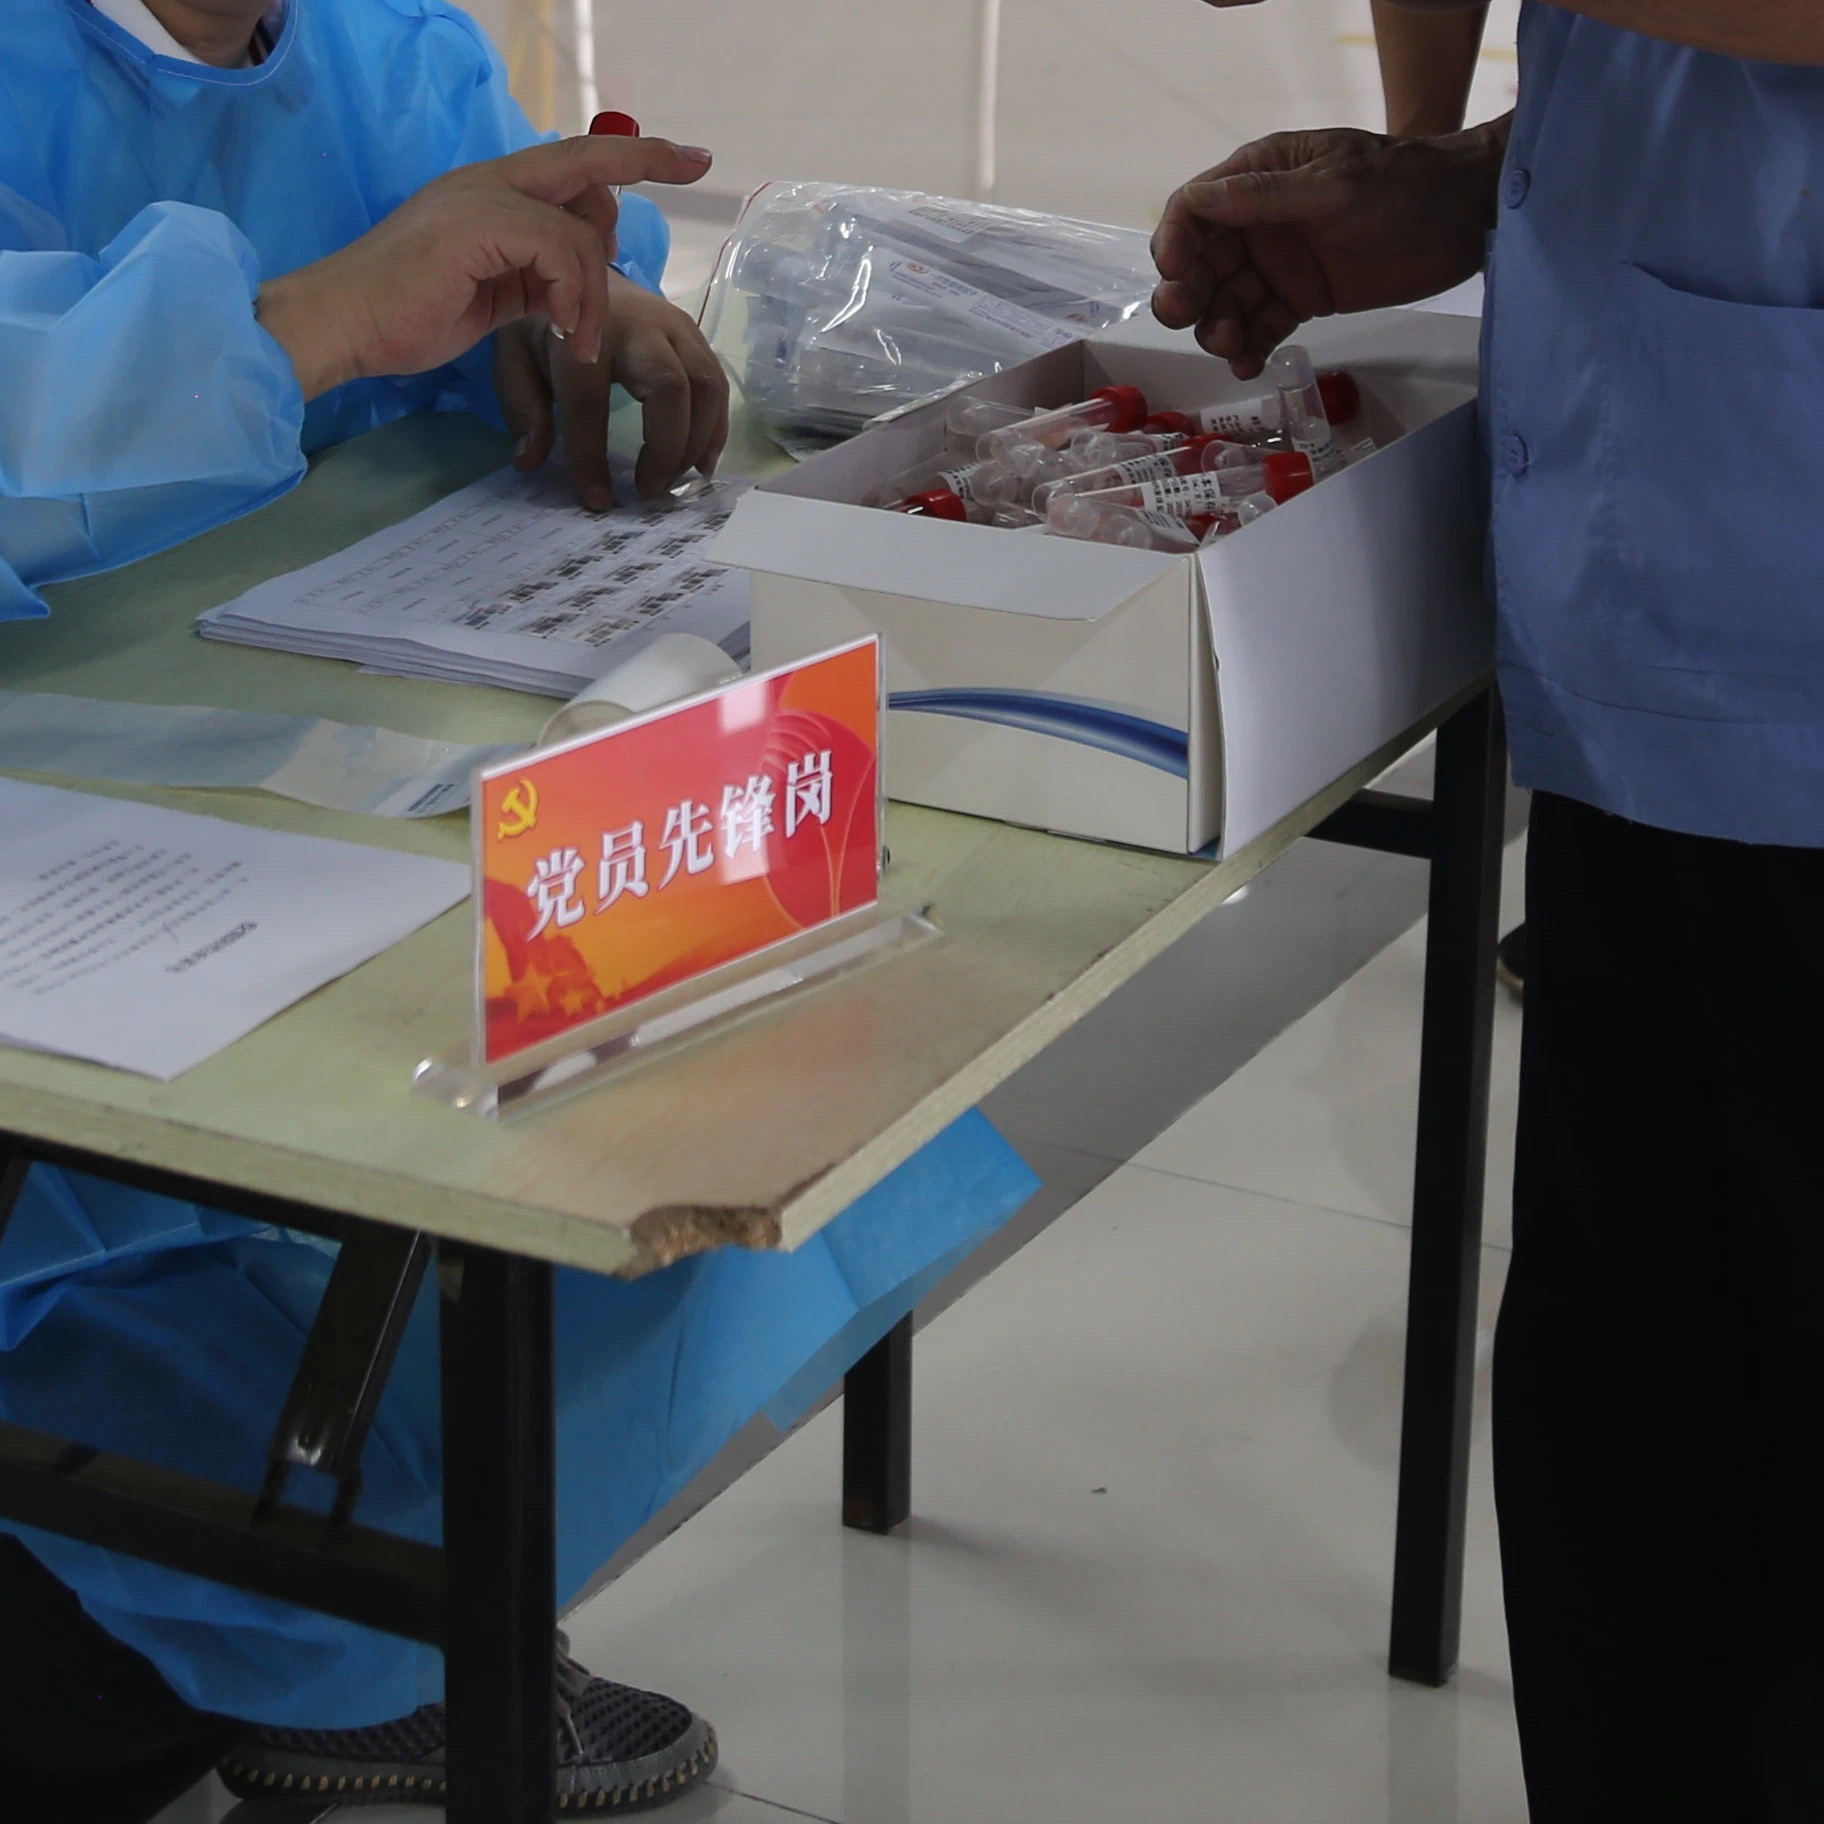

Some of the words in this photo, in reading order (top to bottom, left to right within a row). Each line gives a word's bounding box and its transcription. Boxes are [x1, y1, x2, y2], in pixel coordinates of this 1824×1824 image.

[526, 749, 833, 942] 党员先锋岗
